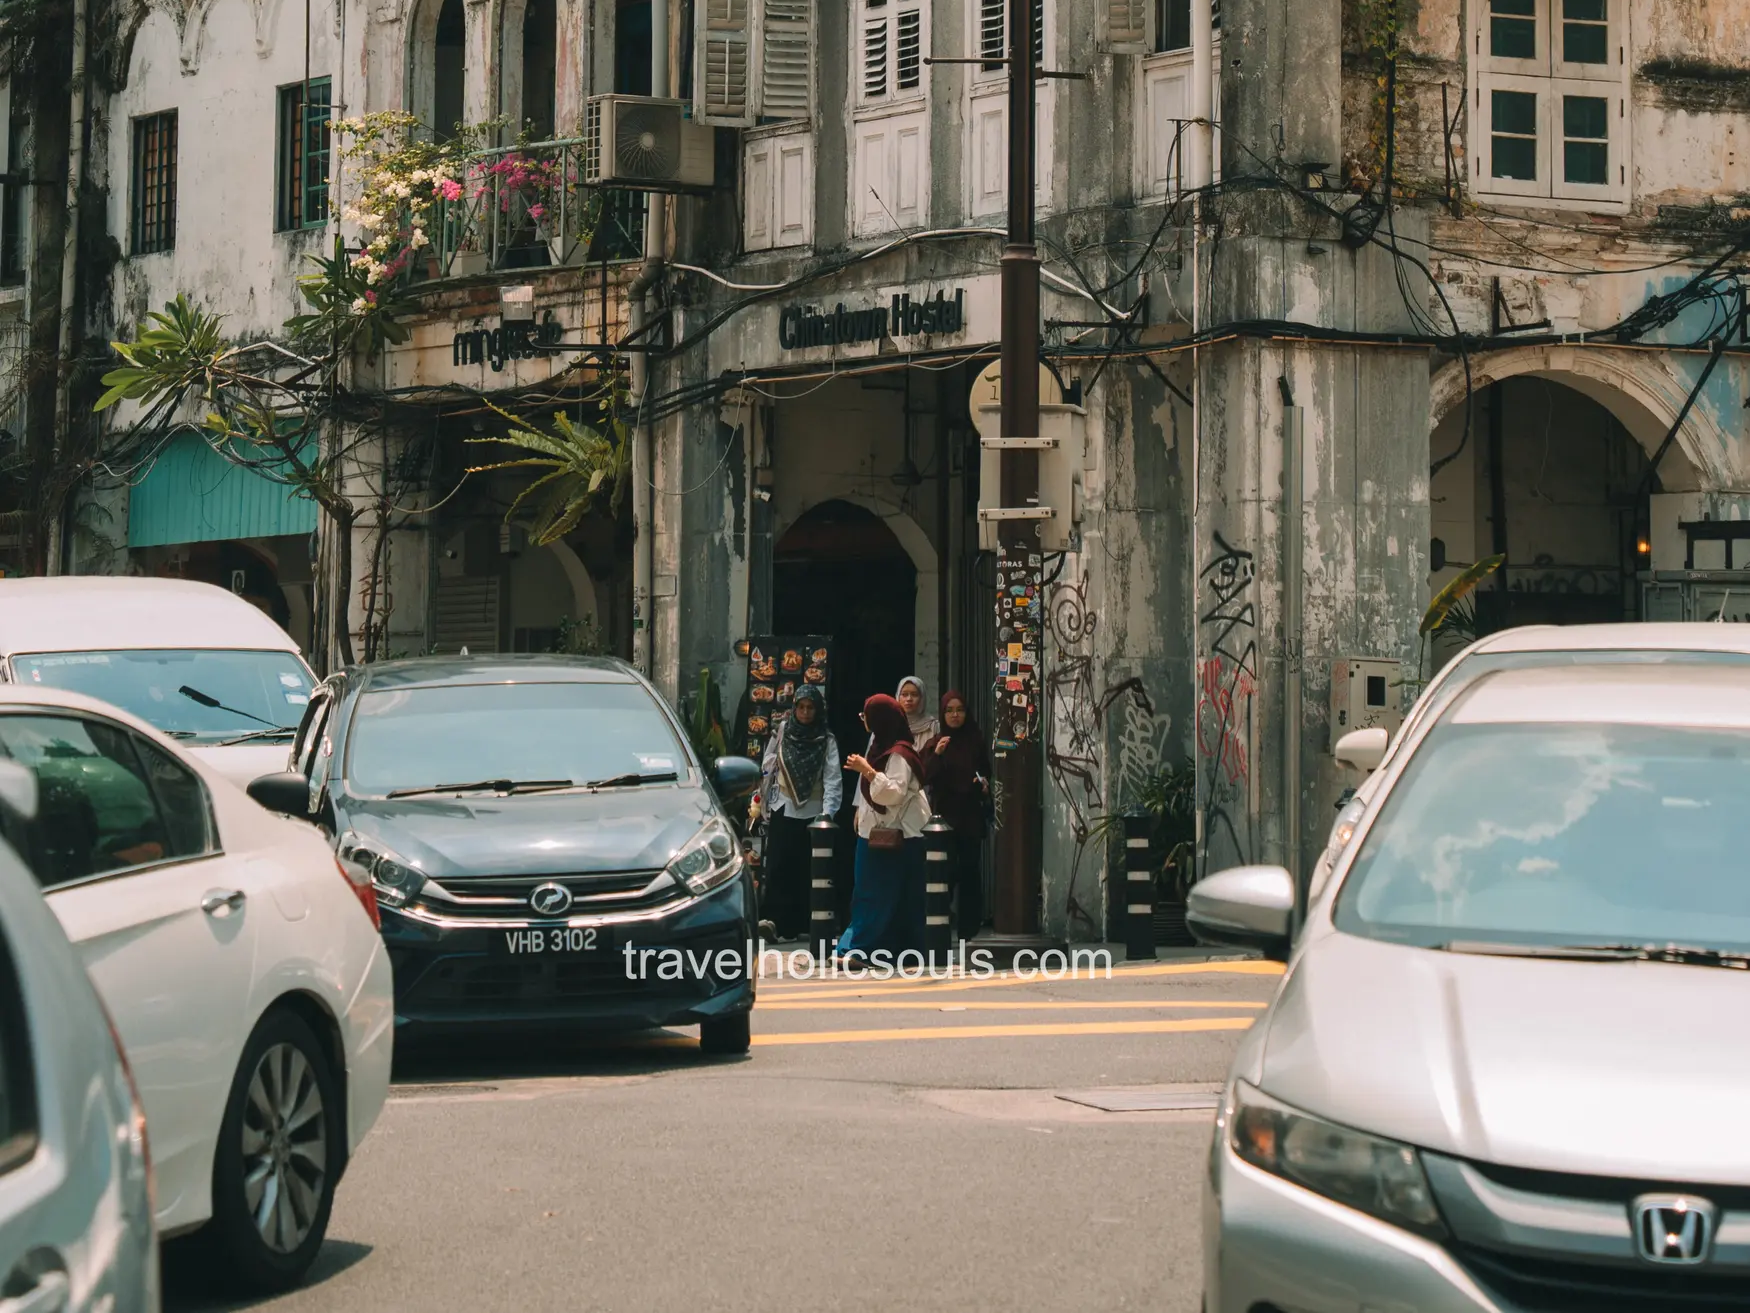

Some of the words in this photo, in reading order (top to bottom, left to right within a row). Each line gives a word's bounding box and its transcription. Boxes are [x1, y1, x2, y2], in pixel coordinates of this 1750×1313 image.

[779, 301, 887, 350] Chinatown
[892, 288, 963, 336] Hostel
[505, 930, 545, 954] VHB
[550, 928, 597, 952] 3102
